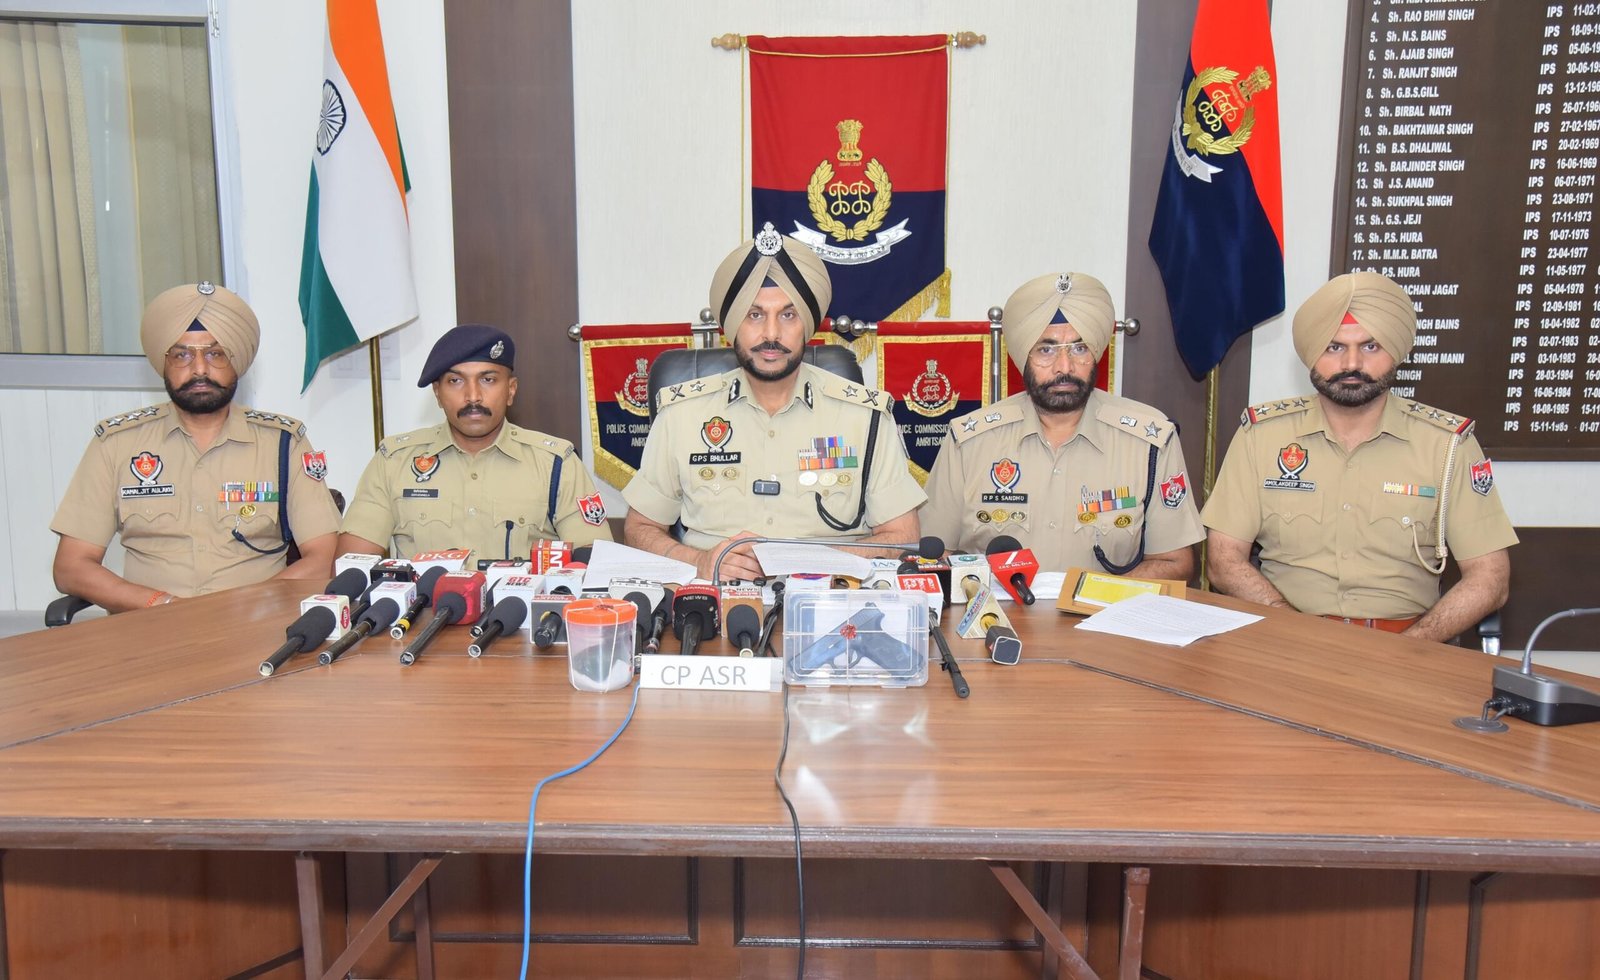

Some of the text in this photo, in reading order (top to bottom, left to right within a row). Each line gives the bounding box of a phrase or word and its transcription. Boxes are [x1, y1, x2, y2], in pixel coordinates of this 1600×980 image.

[1372, 12, 1379, 23] 4.
[1388, 12, 1401, 22] Sh.
[1404, 11, 1421, 22] RAO
[1424, 10, 1445, 21] BHIM
[1448, 9, 1474, 20] SINGH
[1547, 6, 1562, 17] IPS
[1370, 32, 1377, 42] 5.
[1387, 31, 1400, 42] Sh.
[1402, 31, 1418, 41] N.S.
[1421, 30, 1446, 41] BAINS
[1545, 26, 1560, 37] IPS
[1369, 50, 1376, 60] 6.
[1385, 50, 1398, 60] Sh.
[1400, 49, 1425, 59] AJAIB
[1427, 48, 1453, 59] SINGH
[1543, 44, 1558, 55] IPS
[1368, 68, 1374, 79] 7.
[1383, 68, 1396, 79] Sh.
[1399, 67, 1429, 78] RANJIT
[1431, 66, 1457, 78] SINGH
[1541, 63, 1555, 74] IPS
[1366, 88, 1373, 99] 8.
[1381, 88, 1394, 98] Sh.
[1397, 87, 1439, 98] G.B.S.GILL
[1538, 83, 1553, 94] IPS
[1365, 107, 1372, 117] 9.
[1379, 106, 1392, 117] Sh.
[1395, 106, 1424, 116] BIRBAL
[1429, 105, 1451, 116] NATH
[1536, 103, 1551, 114] IPS
[1360, 125, 1371, 136] 10.
[1378, 125, 1391, 135] Sh.
[1393, 124, 1445, 135] BAKHTAWAR
[1447, 124, 1473, 134] SINGH
[1534, 122, 1549, 133] IPS
[1359, 138, 1599, 153] 11. Sh B.S. DHALIWAL IPS 20-02-1969
[1358, 158, 1597, 172] 12. Sh. BARJINDER SINGH IPS 16-06-1969
[1357, 175, 1594, 189] 13. Sh J.S. ANAND IPS 06-07-1971
[1356, 193, 1593, 207] 14. Sh. SUKHPAL SINGH IPS 23-08-1971
[1355, 211, 1591, 225] 15. Sh. G.S. JEJI IPS 17-11-1973
[1354, 229, 1589, 243] 16. Sh. P.S. HURA IPS 10-07-1976
[1353, 247, 1588, 260] 17. Sh. M.M.R. BATRA IPS 23-04-1977
[1398, 267, 1420, 277] HURA
[1520, 265, 1534, 275] IPS
[1546, 265, 1586, 275] 11-05-1977
[1432, 285, 1458, 295] JAGAT
[1518, 284, 1532, 294] IPS
[1544, 283, 1584, 294] 05-04-1978
[1516, 301, 1530, 311] IPS
[1543, 301, 1581, 311] 12-09-1981
[1435, 319, 1459, 329] BAINS
[1515, 318, 1529, 328] IPS
[1541, 318, 1580, 328] 18-04-1982
[1513, 337, 1527, 347] IPS
[1539, 336, 1578, 346] 02-07-1983
[1413, 353, 1438, 363] SINGH
[1440, 353, 1464, 363] MANN
[1511, 353, 1525, 363] IPS
[1538, 353, 1575, 363] 03-10-1983
[1395, 369, 1573, 381] SINGH IPS 28-03-1984
[1507, 387, 1522, 397] IPS
[1534, 387, 1571, 397] 16-06-1984
[1506, 403, 1520, 414] IPS
[1532, 404, 1569, 414] 18-08-1985
[606, 424, 627, 434] POLICE
[1504, 421, 1518, 431] IPS
[710, 454, 738, 462] BHULLAR
[419, 552, 463, 560] PKG
[660, 665, 746, 685] CP ASR
